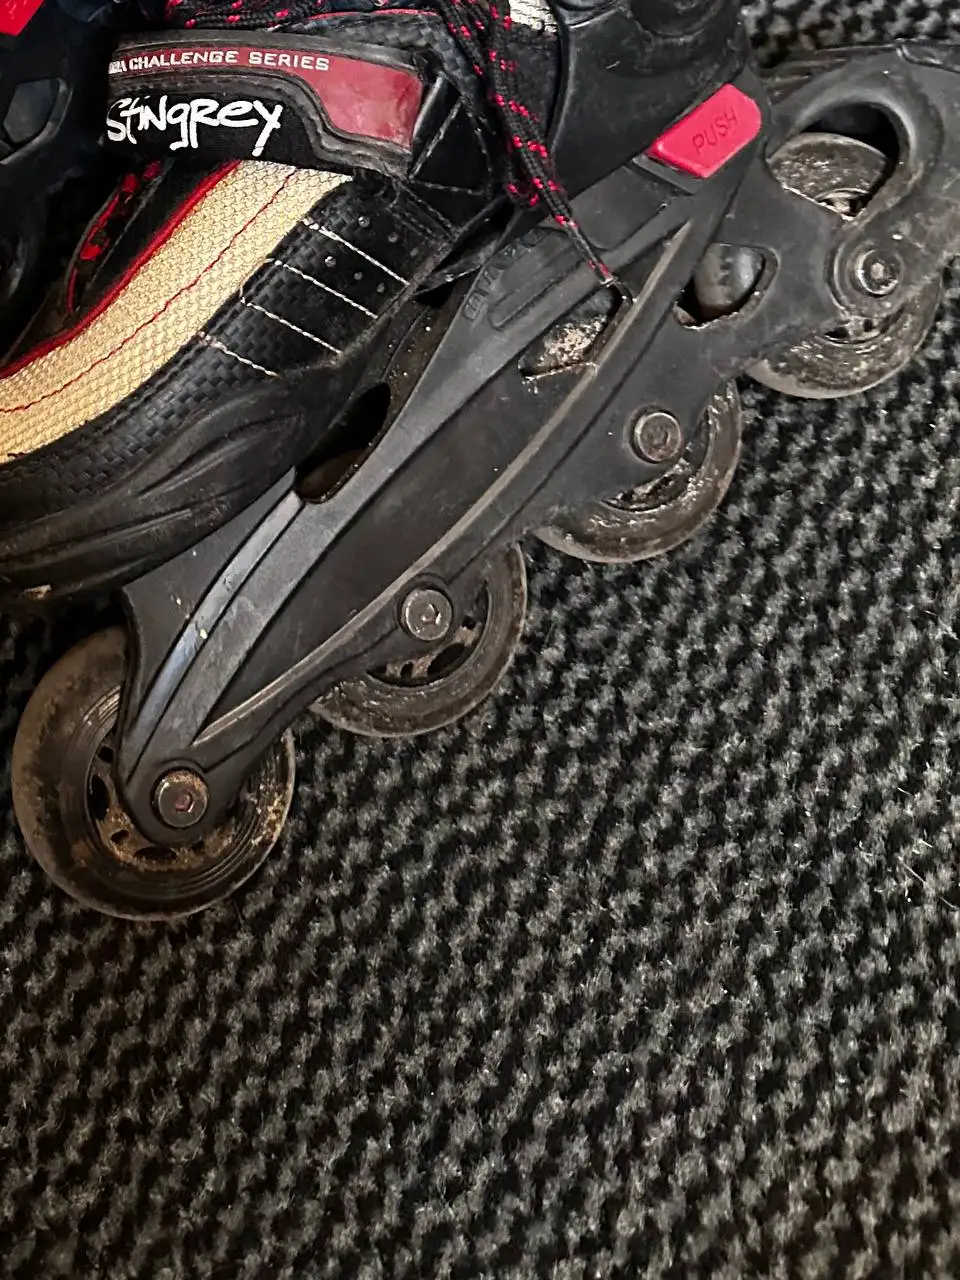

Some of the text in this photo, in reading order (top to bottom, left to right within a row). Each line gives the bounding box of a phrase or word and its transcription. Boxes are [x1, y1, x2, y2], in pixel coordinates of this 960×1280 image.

[129, 51, 238, 70] CHALLENGE
[248, 51, 330, 72] SERIES
[692, 105, 738, 154] PUSH
